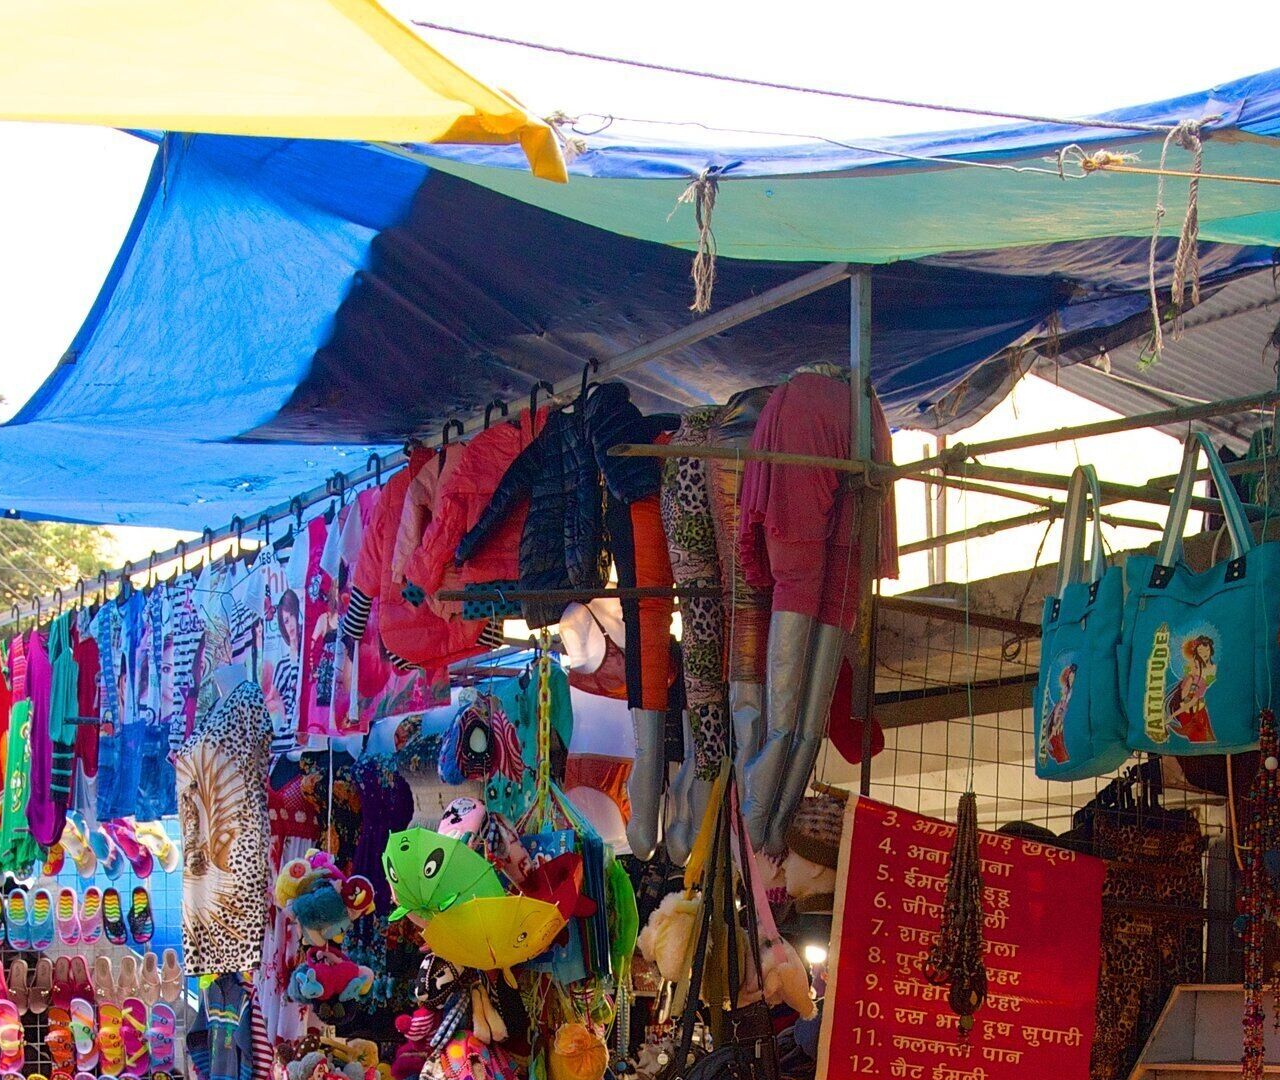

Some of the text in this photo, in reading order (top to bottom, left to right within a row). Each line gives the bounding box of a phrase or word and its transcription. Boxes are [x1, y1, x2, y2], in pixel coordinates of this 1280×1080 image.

[1148, 634, 1169, 731] ATTITUDE
[882, 810, 901, 828] 3.
[912, 819, 957, 839] आम
[1021, 839, 1078, 866] खट्टा
[878, 837, 897, 855] 4.
[907, 843, 951, 866] अना
[876, 863, 894, 882] 5.
[873, 891, 892, 910] 6.
[870, 918, 889, 937] 7.
[868, 946, 886, 966] 8.
[865, 973, 883, 992] 9.
[854, 999, 1084, 1048] 10. रस दूध सुपारी
[851, 1027, 883, 1048] 11.
[981, 1046, 1025, 1066] पान
[849, 1054, 881, 1075] 12.
[889, 1056, 926, 1080] जैट
